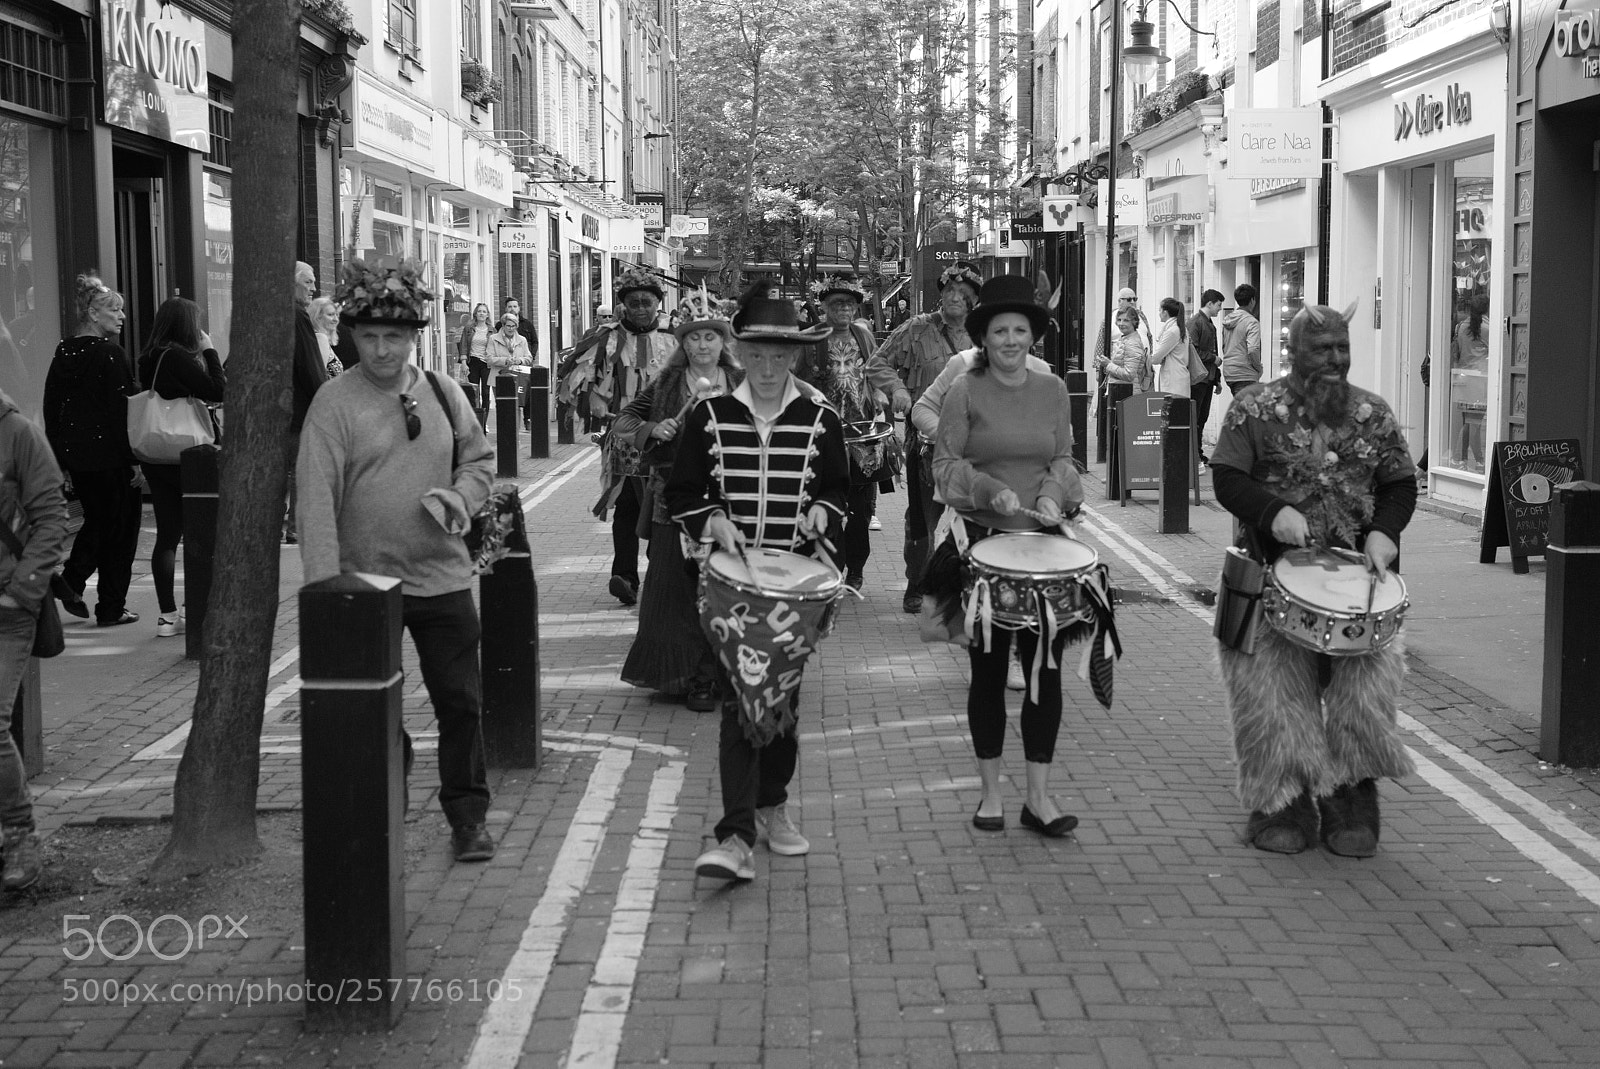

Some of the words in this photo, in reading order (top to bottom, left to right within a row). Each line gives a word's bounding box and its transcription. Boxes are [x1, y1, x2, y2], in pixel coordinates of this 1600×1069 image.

[108, 2, 201, 94] KNOMO
[1415, 93, 1443, 135] Claire
[1447, 83, 1472, 127] Naa
[1241, 133, 1277, 150] Claire
[1283, 133, 1311, 150] Naa
[1153, 213, 1203, 223] OFFSPRING
[1014, 223, 1043, 234] Tabio
[502, 241, 537, 249] SUPERGA
[1503, 442, 1570, 465] BROWHAUS
[1530, 505, 1544, 515] OFF
